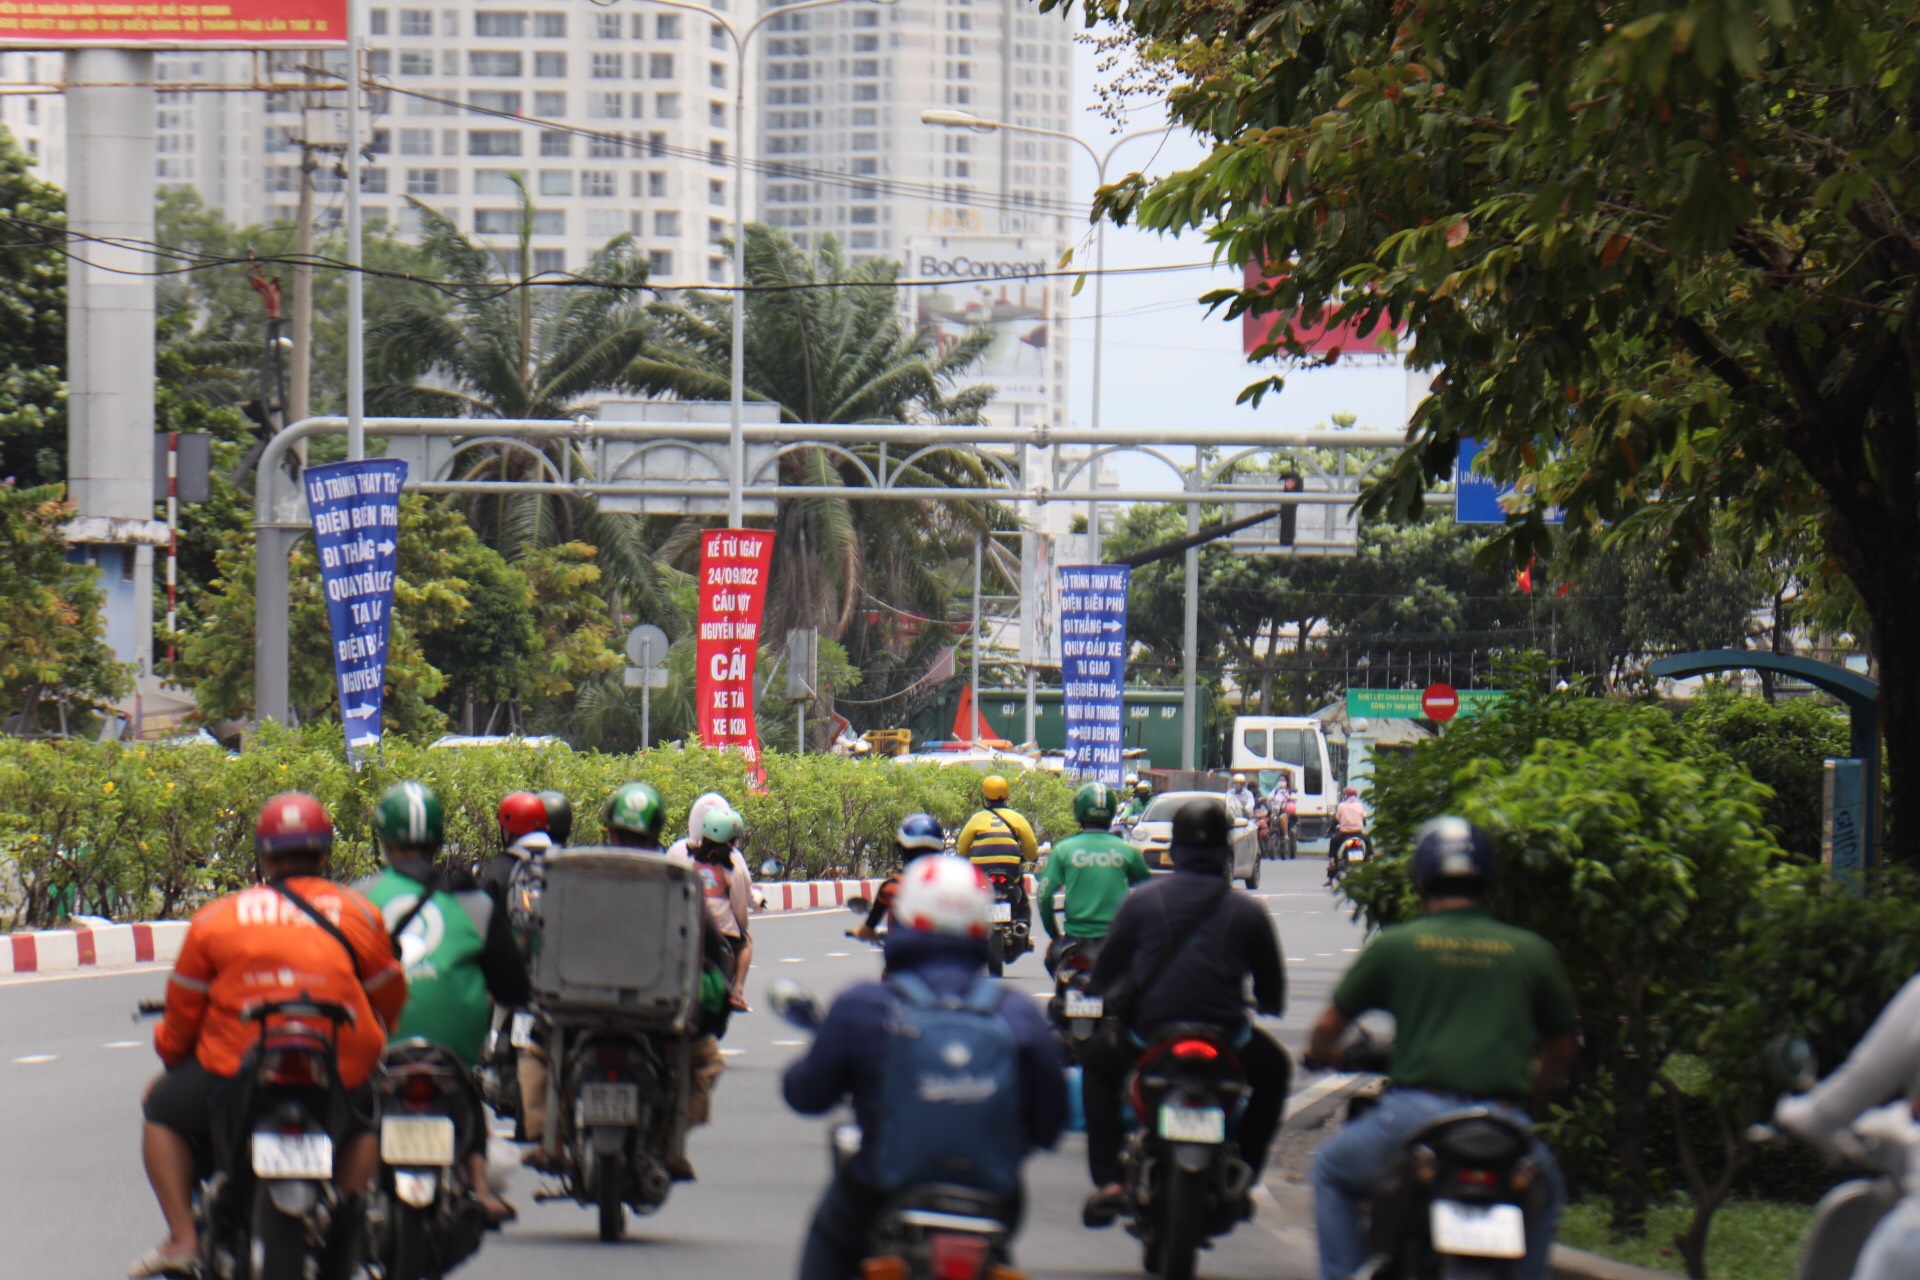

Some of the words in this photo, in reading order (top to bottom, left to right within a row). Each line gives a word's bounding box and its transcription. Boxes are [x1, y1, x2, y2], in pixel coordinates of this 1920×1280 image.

[920, 256, 1047, 283] BoConcept
[310, 476, 326, 507] LỘ
[1107, 642, 1122, 657] XE
[1089, 661, 1111, 678] GIAO
[713, 691, 728, 708] XE
[713, 718, 727, 735] XE
[1093, 744, 1120, 762] PHẢI
[1072, 848, 1124, 869] Grab
